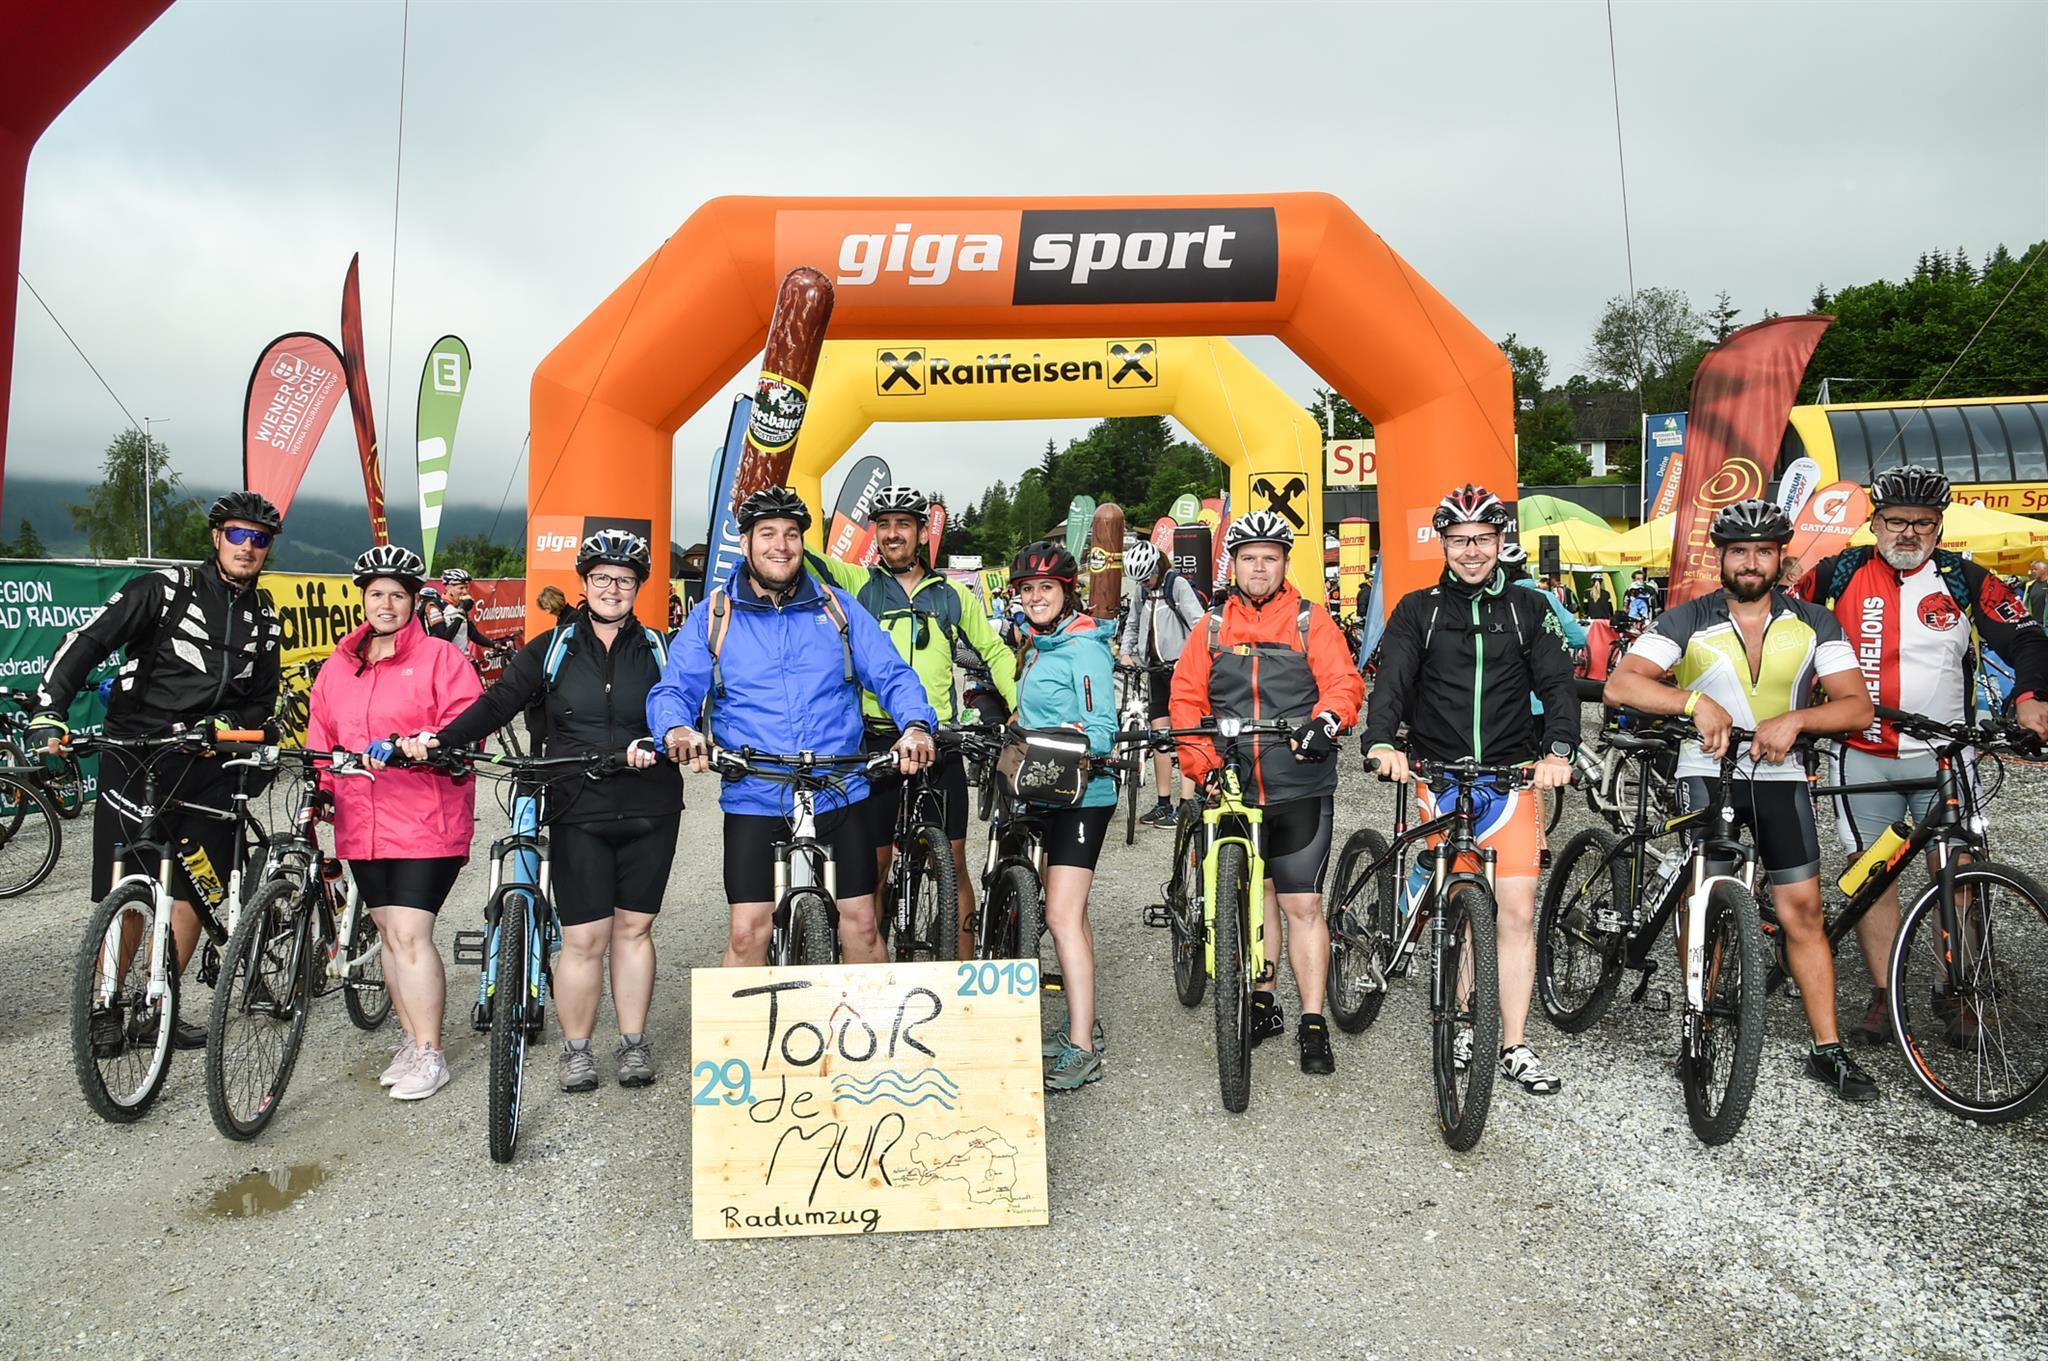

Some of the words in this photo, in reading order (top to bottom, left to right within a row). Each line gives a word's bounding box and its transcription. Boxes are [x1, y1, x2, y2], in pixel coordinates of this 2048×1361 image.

[837, 223, 1003, 287] giga
[1029, 225, 1236, 285] sport
[929, 354, 1103, 387] Raiffeisen
[255, 383, 295, 442] WIENER
[271, 365, 326, 450] STÄDTISCHE
[1656, 455, 1670, 478] Deine
[851, 467, 886, 523] sport
[1784, 472, 1802, 514] GNESIUM
[1794, 475, 1808, 507] SPORT
[536, 532, 578, 552] giga
[1801, 523, 1855, 535] GATORADE
[279, 581, 366, 651] aiffeis
[957, 962, 1038, 997] 2019
[692, 1058, 757, 1106] 29.
[748, 1074, 819, 1123] de
[720, 1205, 882, 1233] Radumzug
